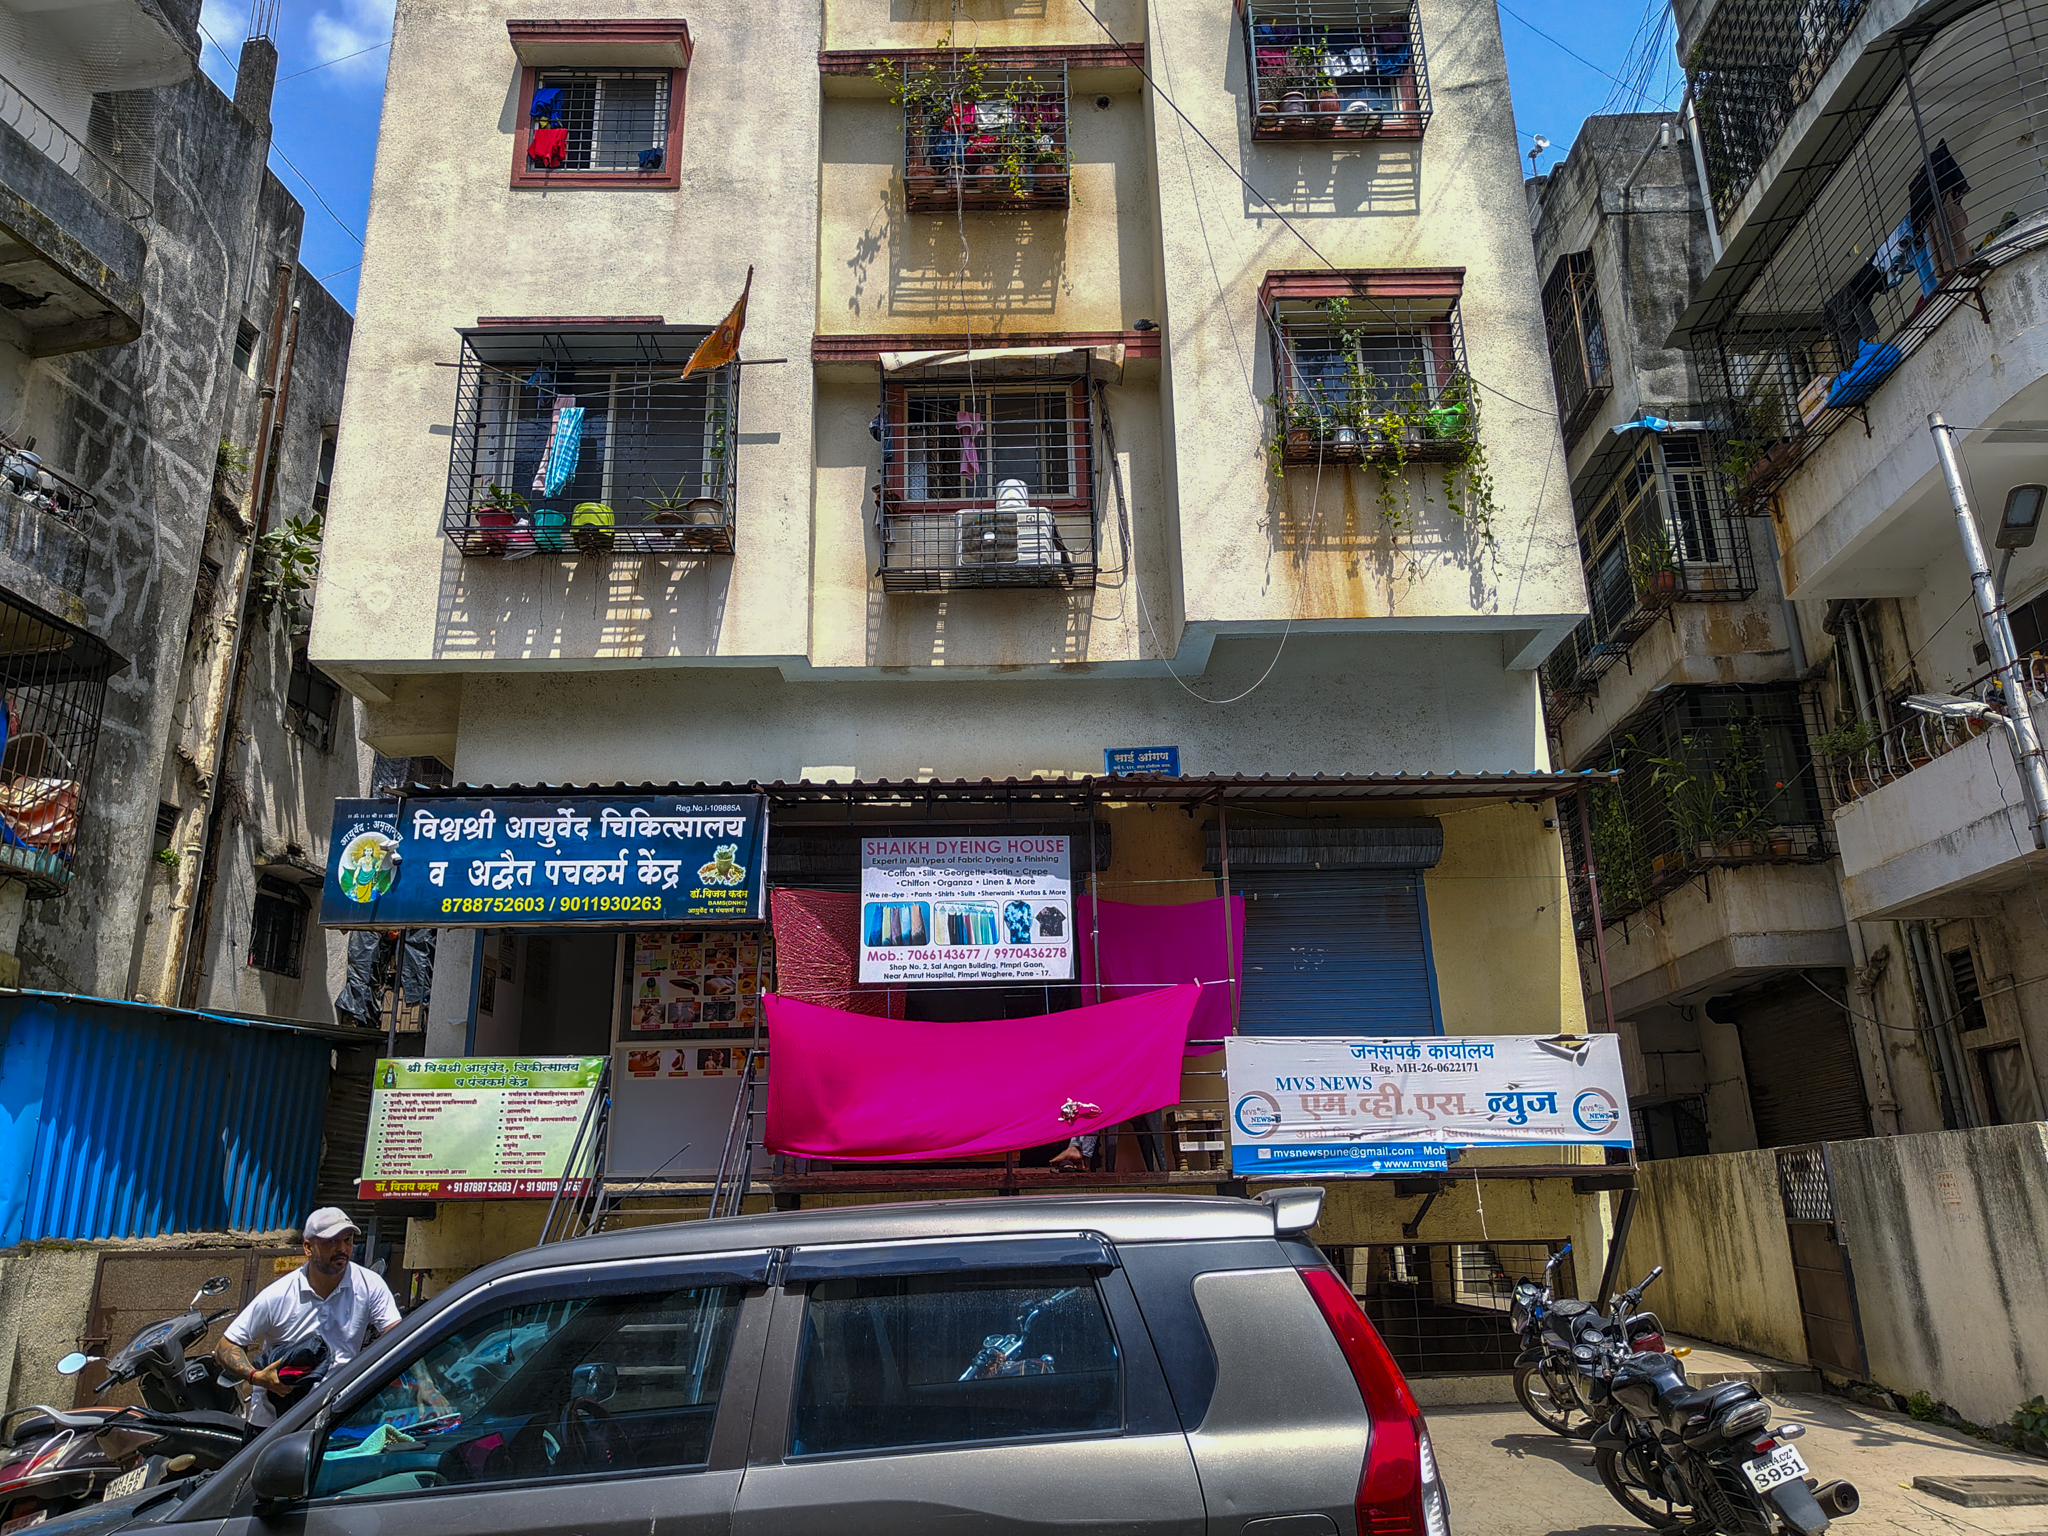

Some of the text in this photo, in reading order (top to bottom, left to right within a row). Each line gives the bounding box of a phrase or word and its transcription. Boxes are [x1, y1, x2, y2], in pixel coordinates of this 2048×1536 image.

[1114, 750, 1134, 763] साई
[505, 808, 592, 848] आयुर्वेद
[600, 807, 747, 840] चिकित्सालय
[866, 839, 1064, 856] SHAIKH DYEING HOUSE
[872, 858, 898, 866] Expert
[922, 857, 946, 866] Types
[948, 856, 956, 864] of
[958, 856, 983, 864] Fabric
[986, 856, 1014, 864] Dyeing
[1024, 855, 1058, 864] Finishing
[428, 848, 682, 890] व अद्वैत पंचकर्म केंद्र
[888, 870, 916, 878] Cotton
[944, 868, 986, 878] Georgette
[993, 868, 1013, 876] Satin
[1022, 868, 1048, 876] Crepe
[937, 879, 973, 888] Organza
[982, 878, 1004, 886] Linen
[1014, 878, 1036, 886] More
[728, 888, 748, 899] कदम
[882, 892, 905, 900] re-dye
[938, 890, 955, 898] Shirts
[1049, 888, 1066, 896] More
[441, 897, 545, 913] 8788752603
[560, 896, 662, 912] 9011930263
[867, 950, 903, 962] Mob.:
[908, 949, 980, 960] 7066143677
[994, 948, 1067, 958] 9970436278
[931, 962, 942, 970] Sai
[944, 962, 966, 970] Angan
[884, 972, 900, 980] Near
[926, 972, 956, 980] Hospital,
[981, 970, 1014, 978] Waghere,
[1427, 1040, 1494, 1060] कार्यालय
[406, 1062, 420, 1072] श्री
[1370, 1062, 1478, 1074] Reg. MH-26-0622171
[456, 1076, 529, 1088] व पंचकर्म केंद्र
[1276, 1076, 1372, 1091] MVS NEWS
[1274, 1146, 1414, 1158] mvsnewspune@gmail.com
[390, 1180, 416, 1192] विजय
[454, 1182, 462, 1192] 91
[464, 1182, 486, 1192] 87887
[488, 1182, 512, 1192] 52603
[526, 1182, 536, 1192] 91
[536, 1181, 558, 1192] 90119
